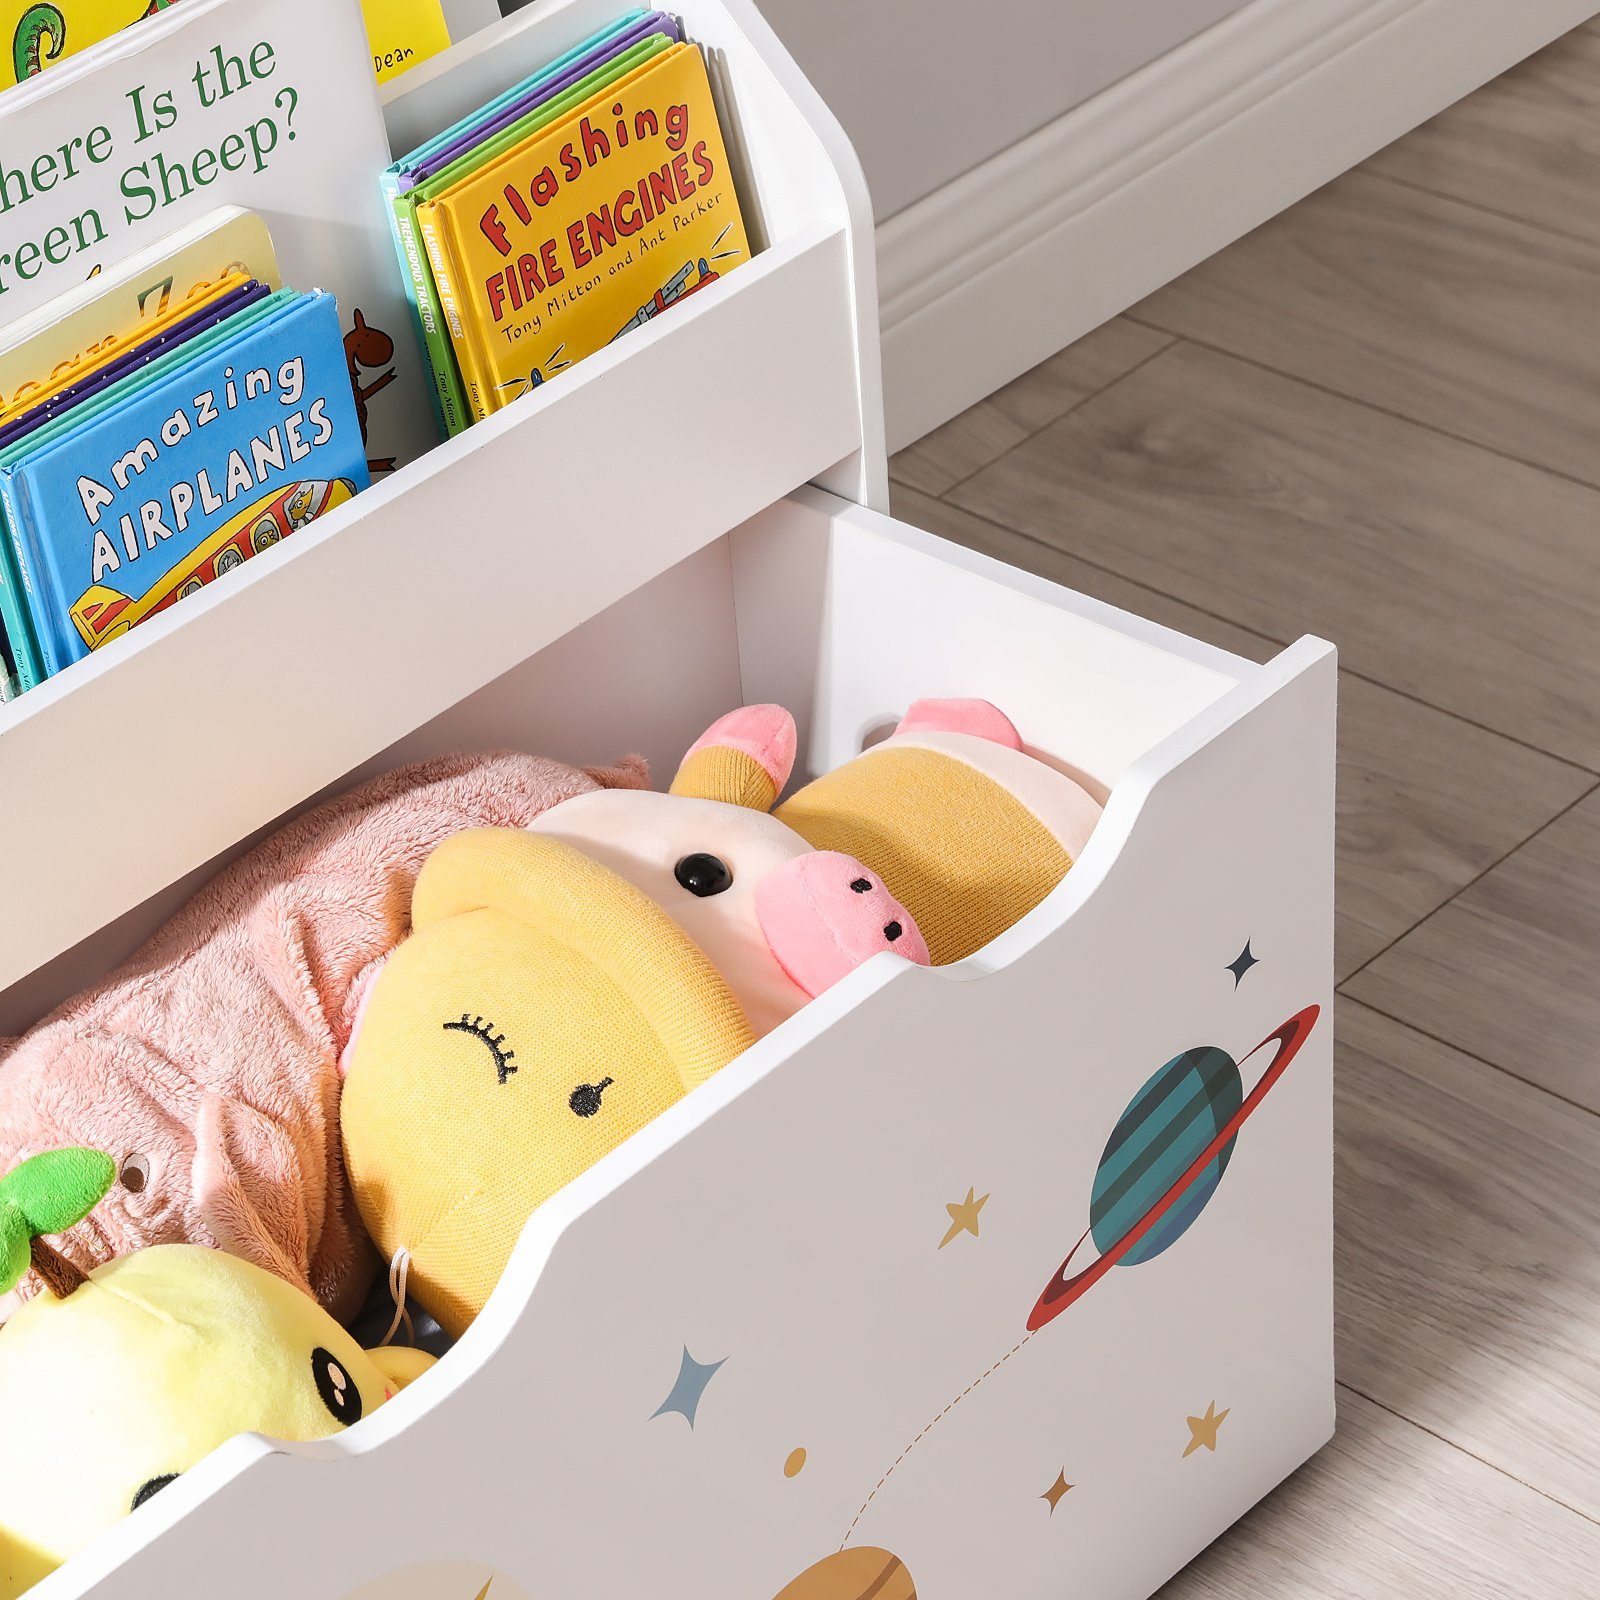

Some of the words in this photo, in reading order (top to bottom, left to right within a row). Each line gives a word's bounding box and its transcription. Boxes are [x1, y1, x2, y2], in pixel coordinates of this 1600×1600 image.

[125, 85, 178, 144] Is
[192, 41, 276, 108] the
[374, 47, 414, 73] Dean
[119, 87, 298, 226] Sheep?
[480, 102, 689, 257] Flashing
[398, 216, 424, 283] TREMENDOUS
[416, 285, 437, 334] TRACTORS
[423, 224, 445, 272] FLASHING
[437, 274, 452, 295] FIRE
[485, 238, 565, 322] FIRE
[566, 140, 714, 269] ENGINES
[501, 315, 542, 343] Tony
[547, 274, 601, 316] Mitton
[608, 251, 633, 275] and
[639, 229, 667, 255] Ant
[672, 192, 722, 231] Parker
[444, 297, 464, 339] ENGINES
[76, 356, 305, 525] Amazing
[438, 371, 449, 394] Tony
[445, 397, 457, 427] Mitton
[470, 381, 480, 404] Tony
[91, 398, 334, 582] AIRPLANES
